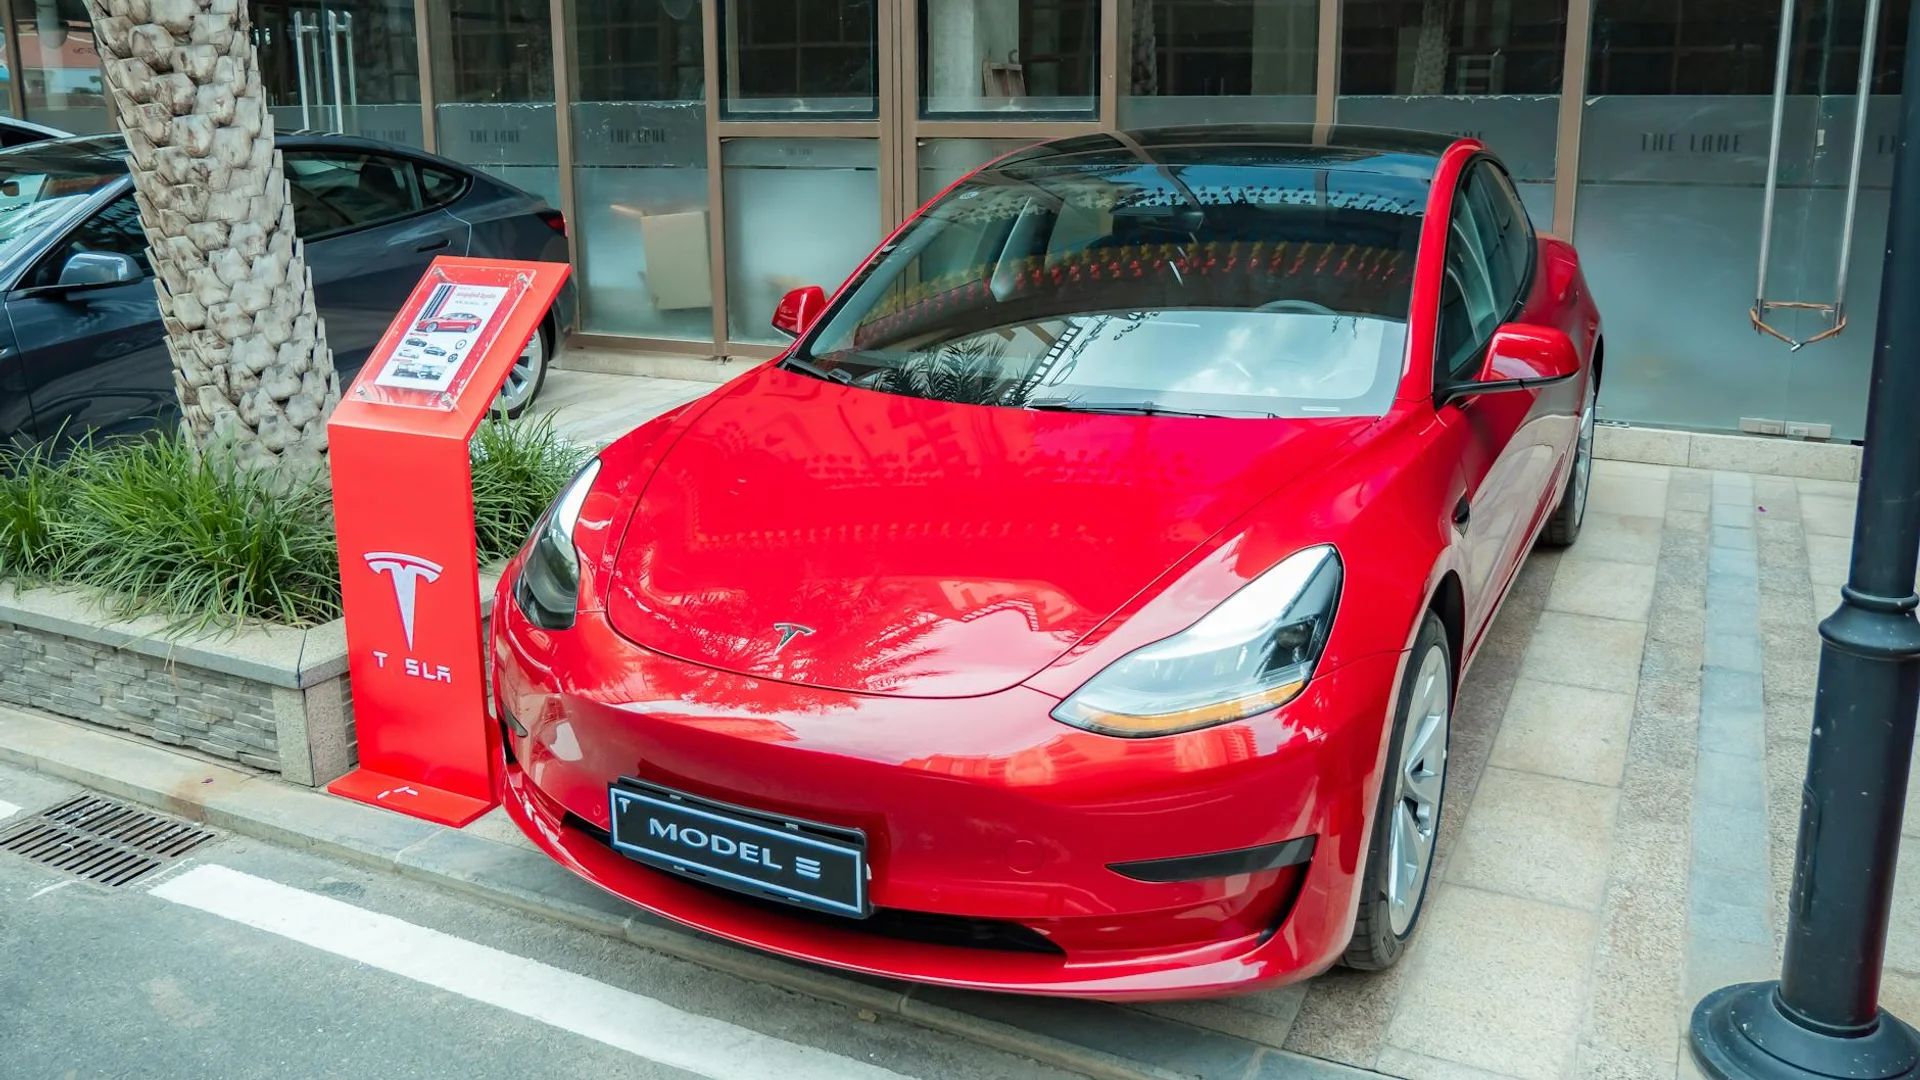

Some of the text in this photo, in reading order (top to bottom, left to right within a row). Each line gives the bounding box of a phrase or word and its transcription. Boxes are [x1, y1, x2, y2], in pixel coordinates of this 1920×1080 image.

[1640, 132, 1745, 153] THE LANE
[649, 818, 783, 870] MODEL
